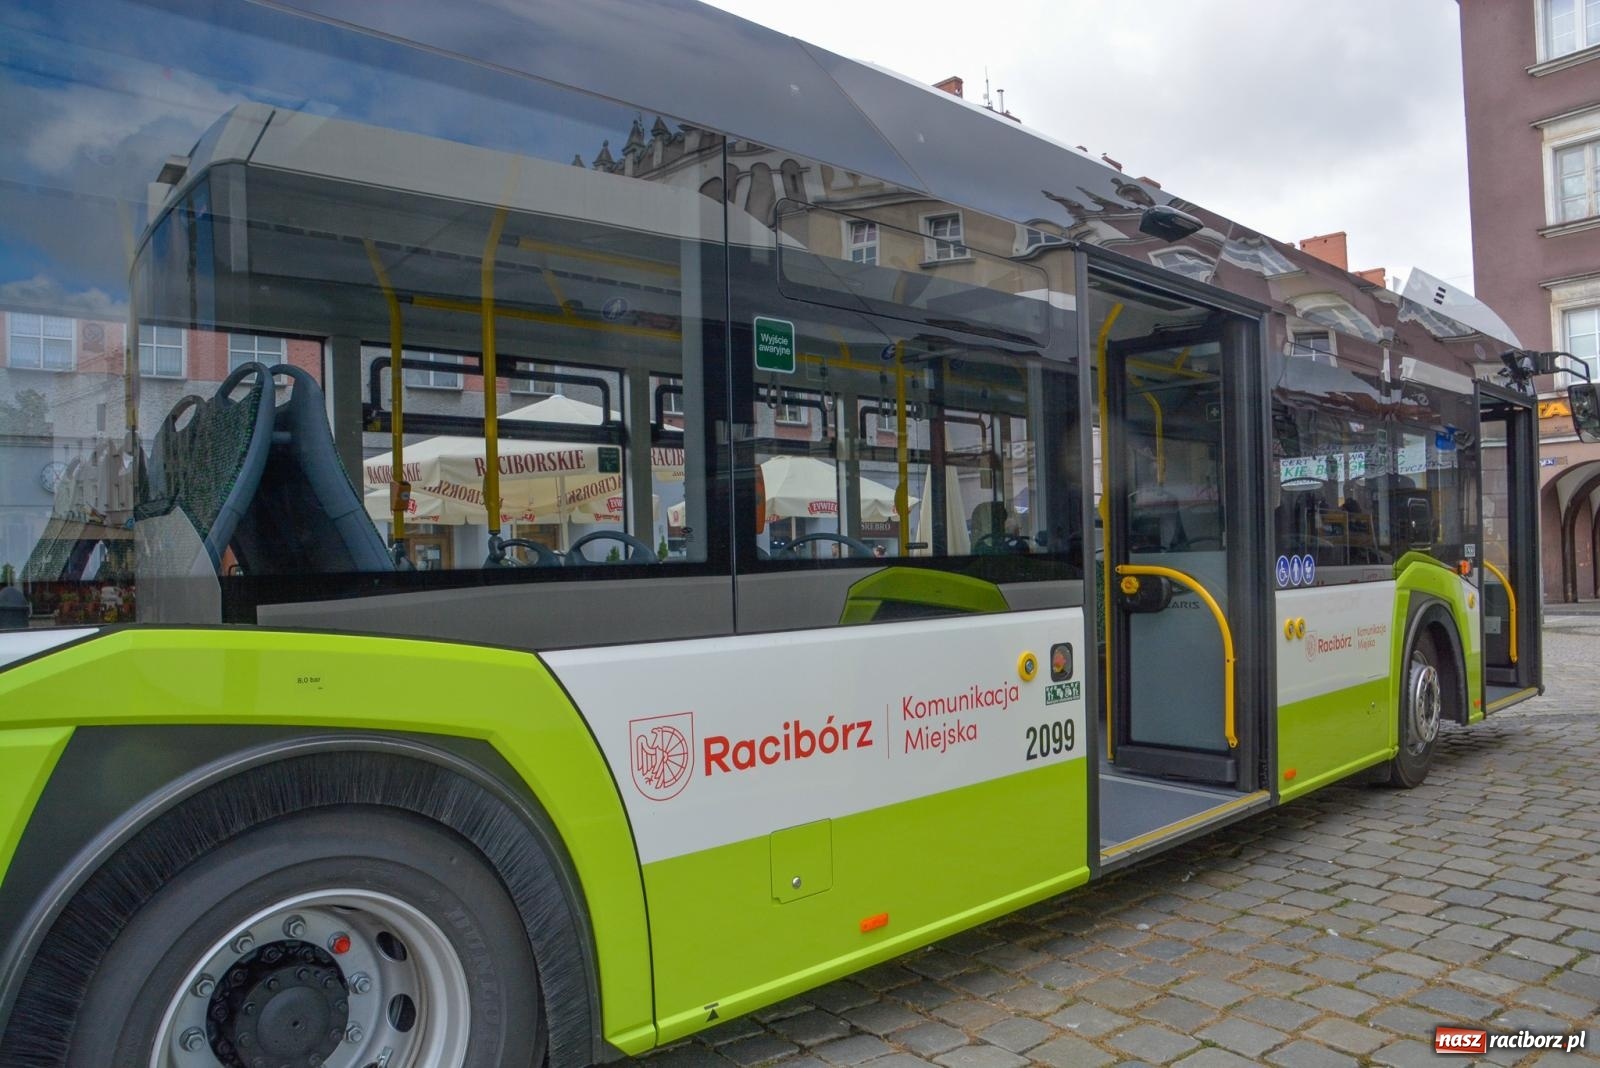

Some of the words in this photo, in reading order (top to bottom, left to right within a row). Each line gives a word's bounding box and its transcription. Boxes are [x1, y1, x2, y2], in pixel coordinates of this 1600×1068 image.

[758, 344, 791, 356] awaryjne
[760, 333, 789, 346] Wyjście
[367, 462, 422, 485] RACIBSKIE
[474, 449, 586, 477] RCIBORSKIE
[1167, 601, 1200, 609] ARIS
[1318, 634, 1352, 653] Racibórz
[902, 681, 1020, 721] Komunikacja
[703, 715, 873, 777] Racibórz
[905, 719, 978, 754] Miejska
[1026, 718, 1075, 761] 2099
